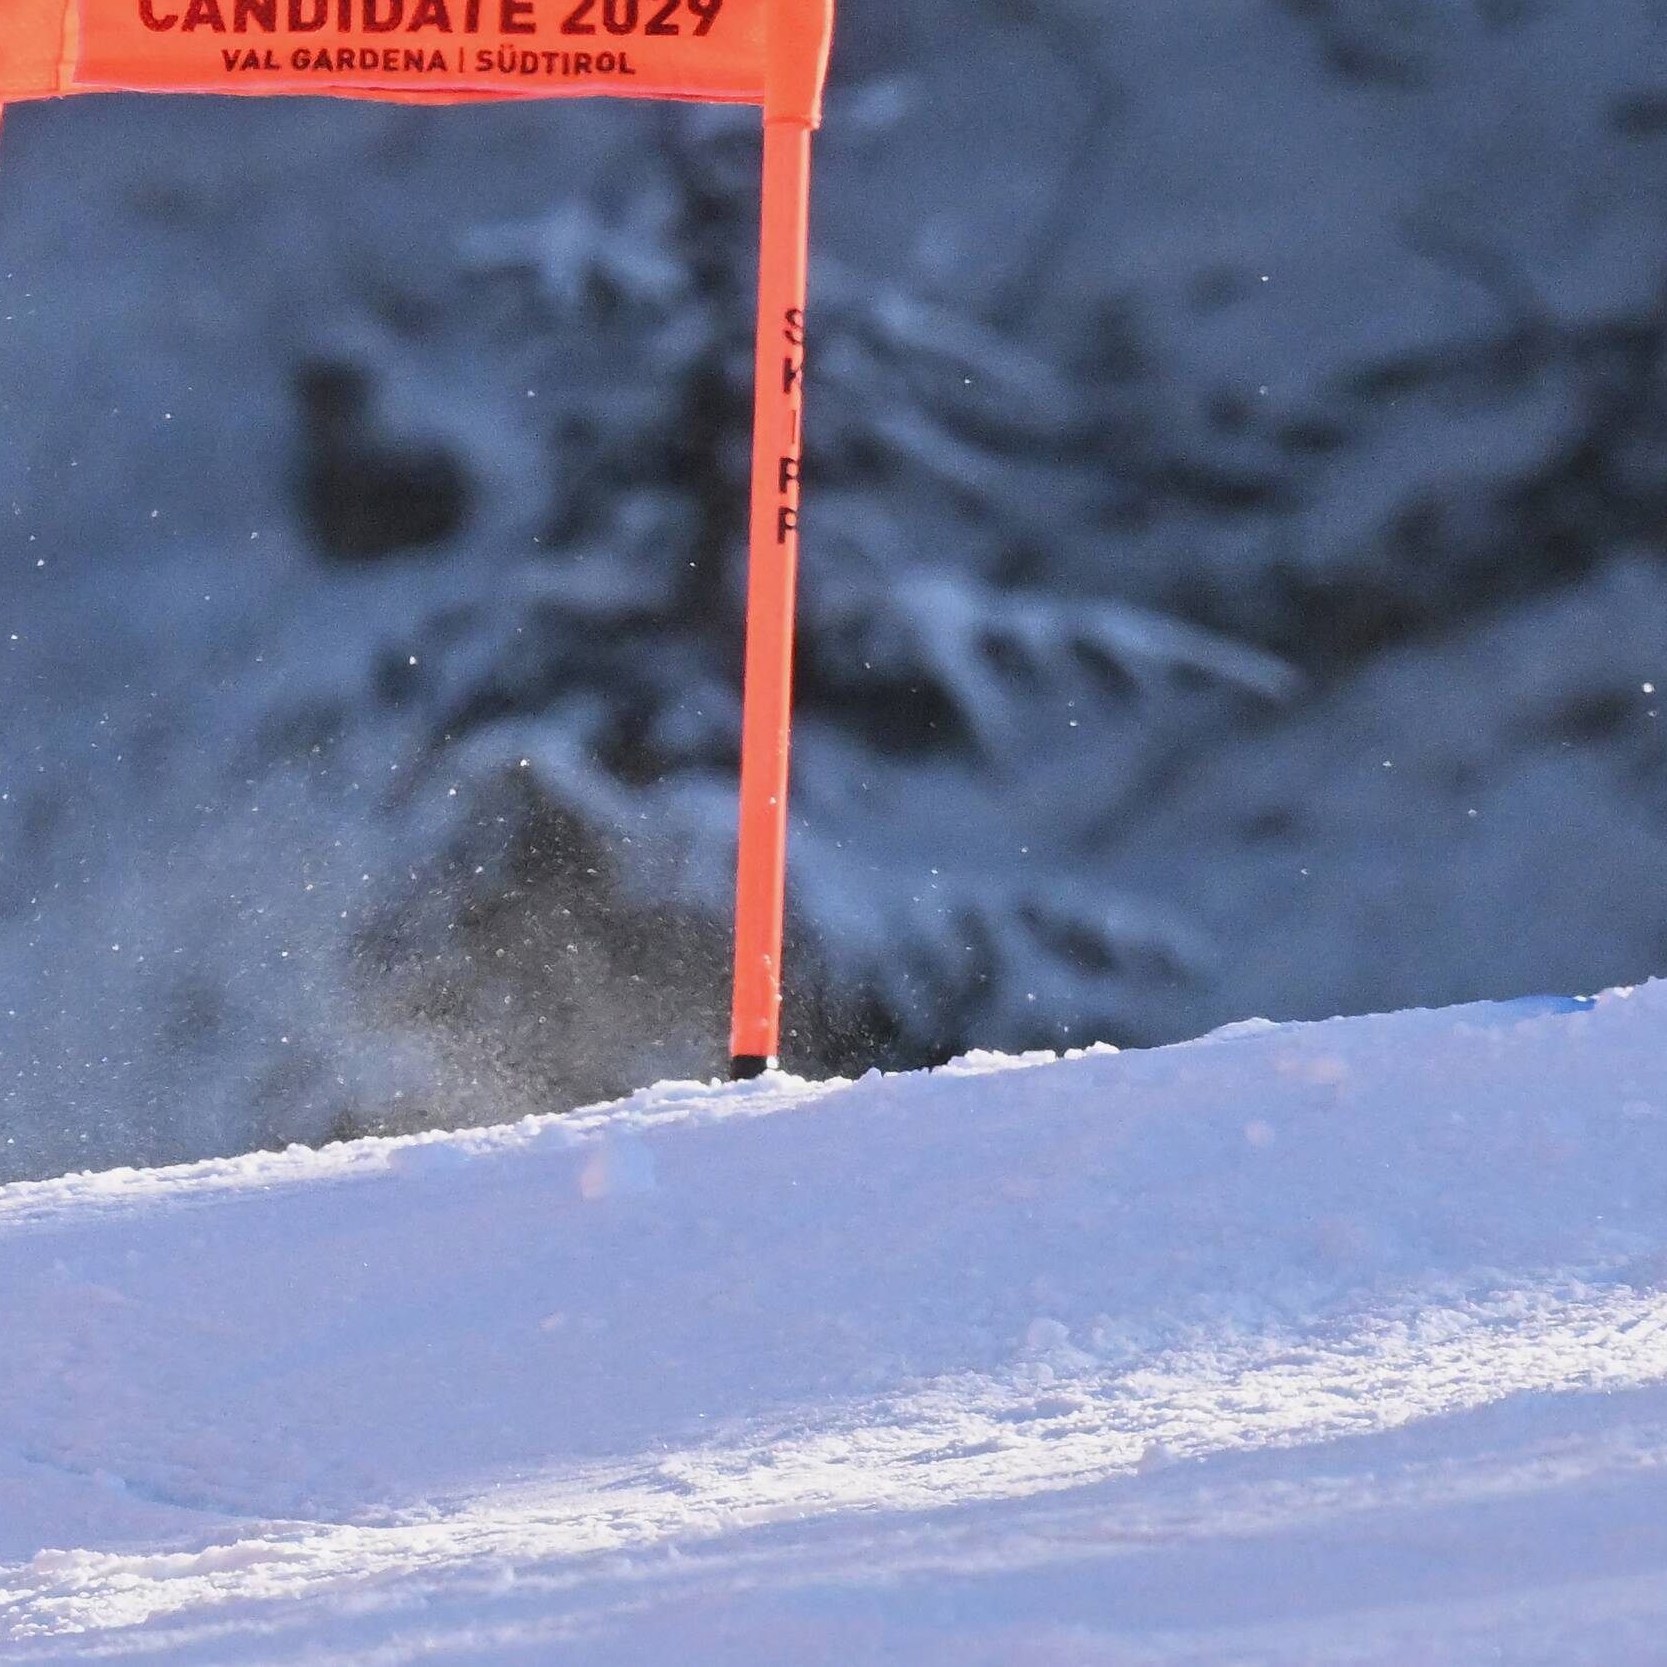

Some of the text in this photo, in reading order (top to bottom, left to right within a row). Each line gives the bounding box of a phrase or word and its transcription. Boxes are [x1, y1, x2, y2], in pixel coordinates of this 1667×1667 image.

[221, 44, 637, 75] VAL GARDENA SÜDTIROL
